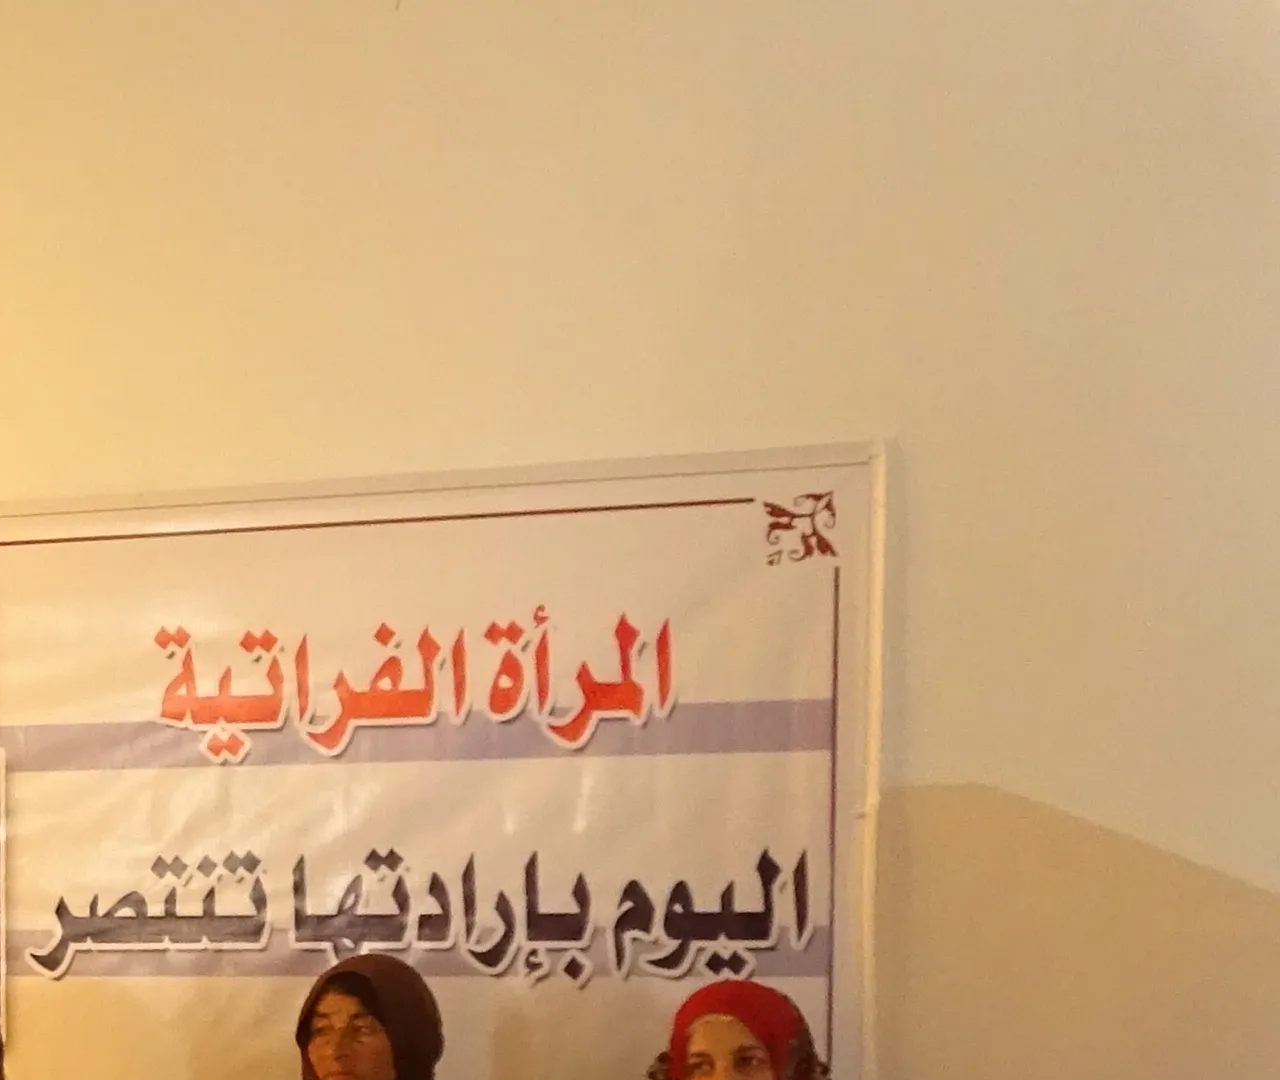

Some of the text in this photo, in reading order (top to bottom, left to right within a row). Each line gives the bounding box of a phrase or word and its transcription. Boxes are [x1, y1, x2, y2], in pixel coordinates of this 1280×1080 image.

[153, 605, 673, 758] المرأة الفراتية
[30, 847, 812, 979] اليوم بإرادتها تنتصر
